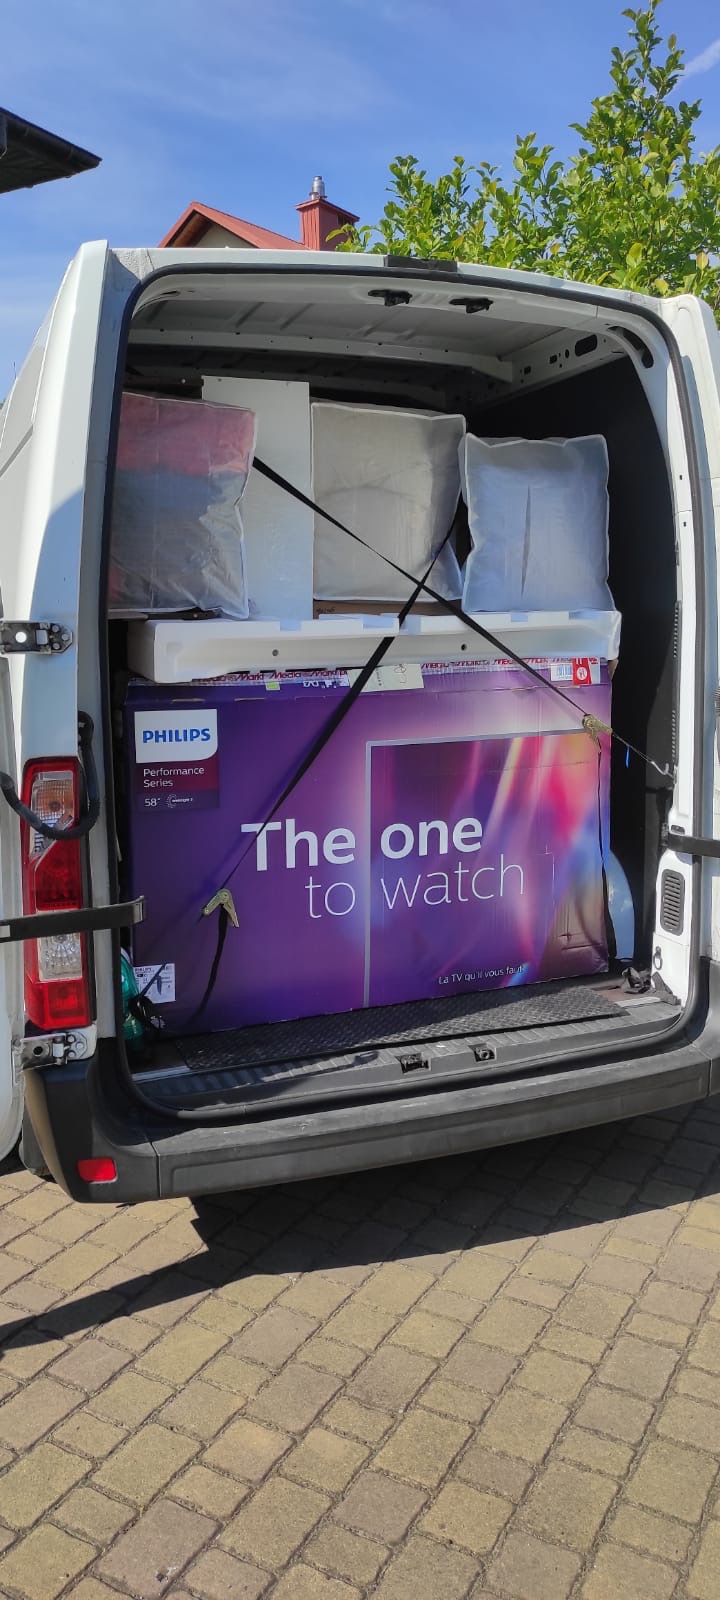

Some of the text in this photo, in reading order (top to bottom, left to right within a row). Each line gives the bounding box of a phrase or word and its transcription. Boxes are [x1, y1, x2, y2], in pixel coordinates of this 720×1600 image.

[270, 671, 301, 679] Media
[142, 728, 211, 743] PHILIPS
[143, 767, 205, 777] Performance
[143, 779, 174, 788] Series
[241, 817, 483, 871] The one
[304, 853, 524, 918] to watch
[438, 976, 449, 985] La
[451, 973, 463, 982] TV
[464, 970, 483, 981] qu'il
[484, 968, 505, 978] vous
